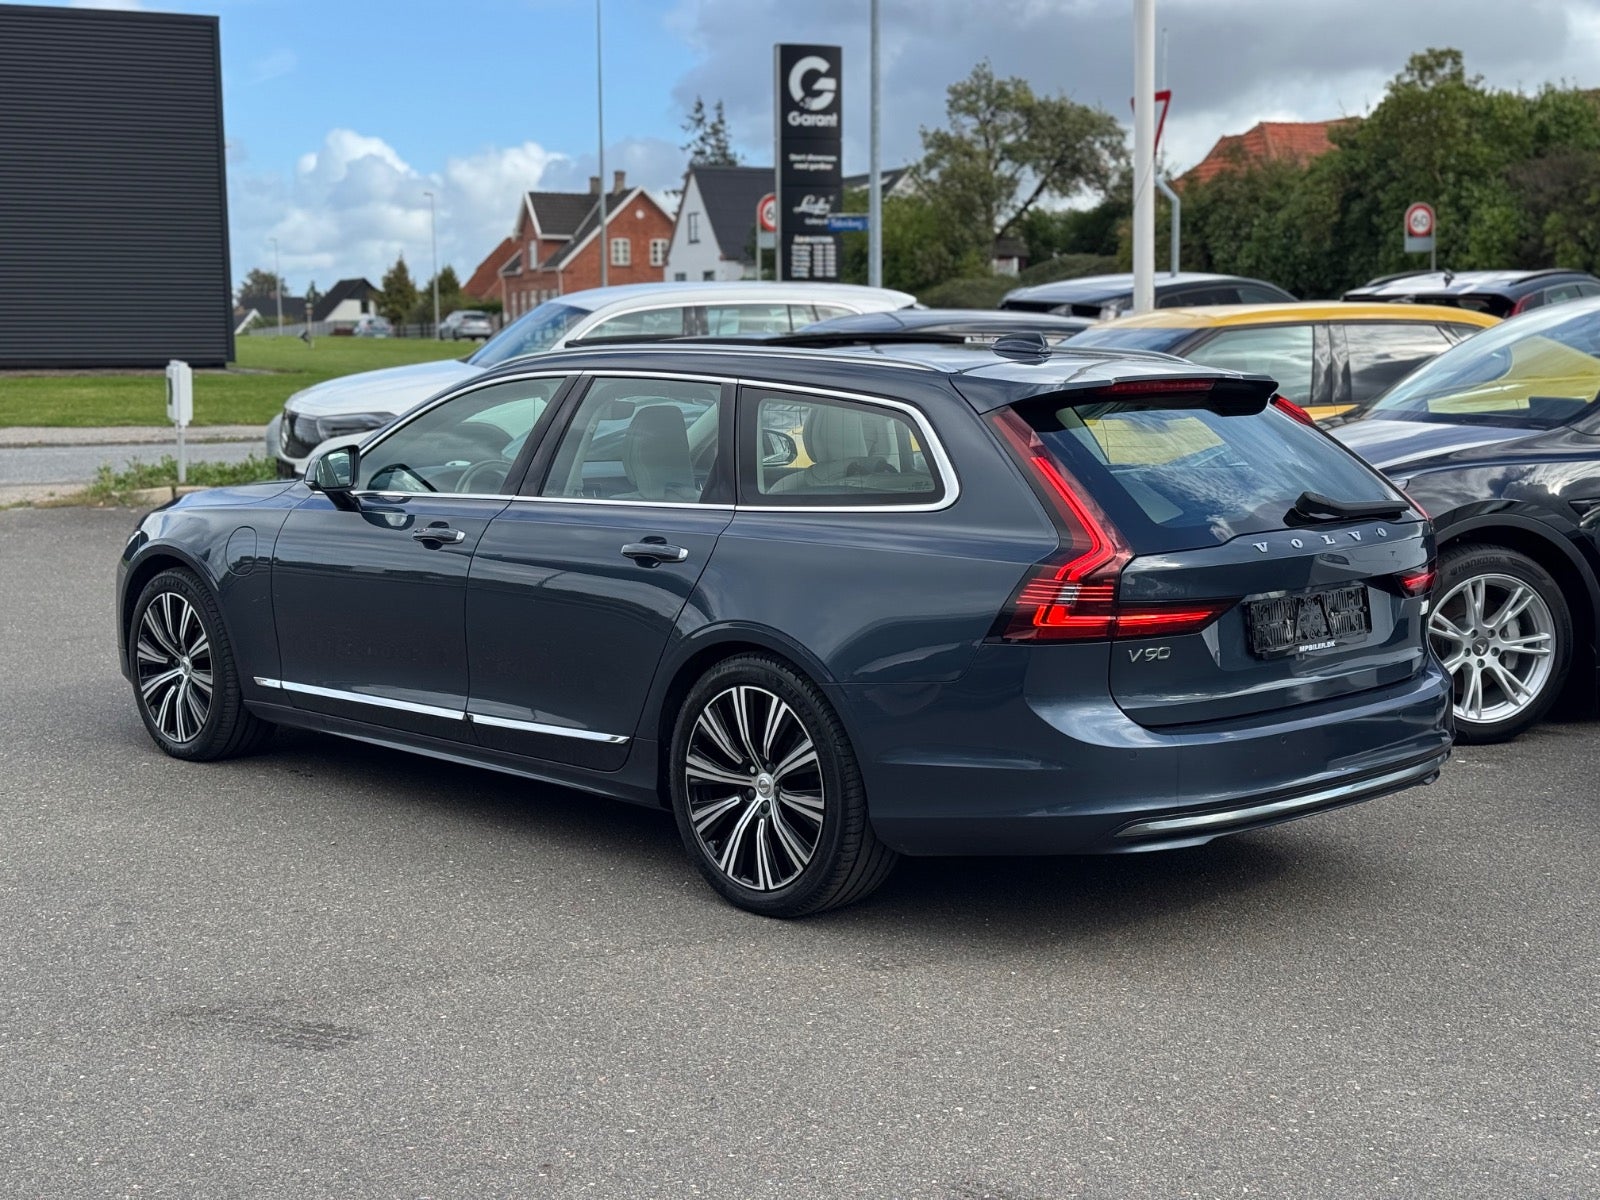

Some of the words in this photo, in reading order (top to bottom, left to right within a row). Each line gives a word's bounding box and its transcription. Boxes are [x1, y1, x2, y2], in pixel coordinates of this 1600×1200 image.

[787, 110, 838, 127] Garant
[1412, 213, 1429, 228] 60
[1253, 527, 1387, 553] VOLVO
[1128, 646, 1171, 662] V90
